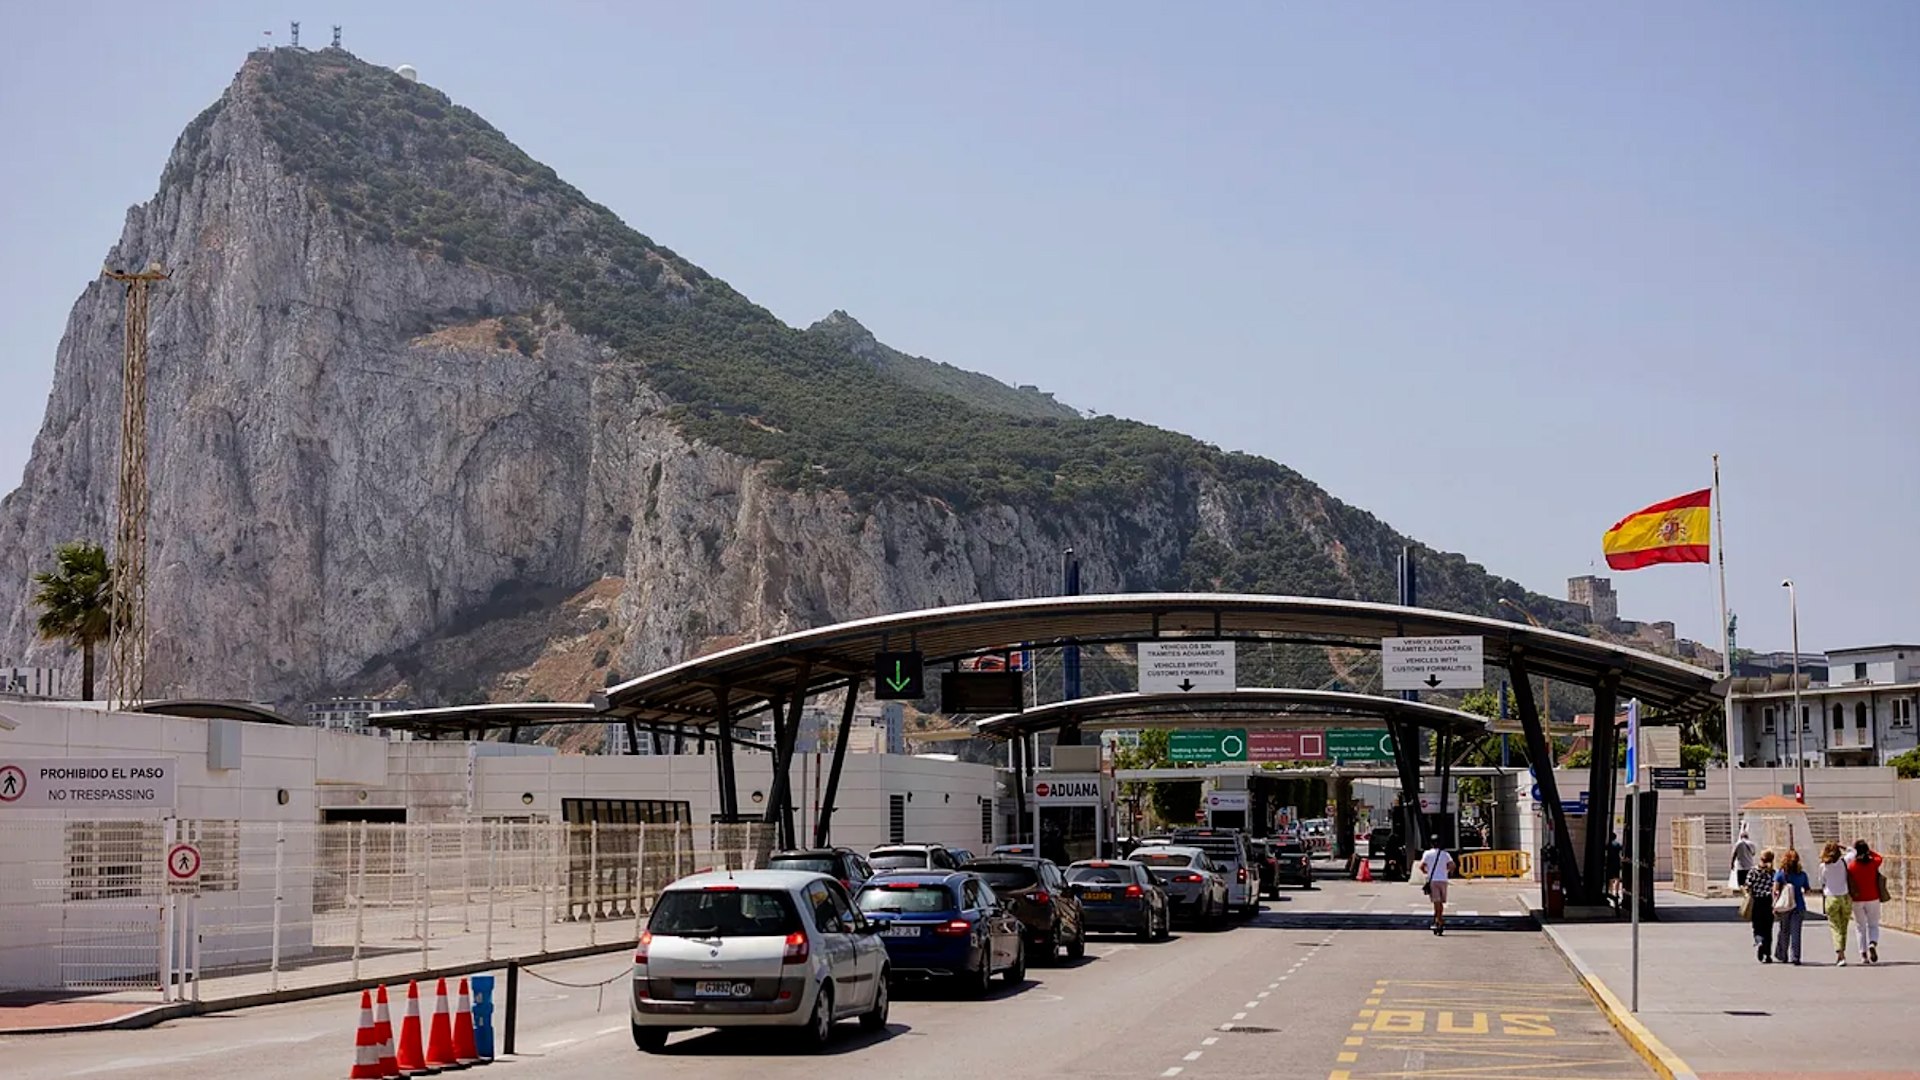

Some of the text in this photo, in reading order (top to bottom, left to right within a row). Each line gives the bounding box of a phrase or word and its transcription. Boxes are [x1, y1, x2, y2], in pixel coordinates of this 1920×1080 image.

[40, 767, 164, 779] PROHIBIDO EL PASO
[48, 789, 154, 801] NO TRESPASSING
[1050, 783, 1099, 797] ADUANA
[1371, 1009, 1557, 1036] BUS
